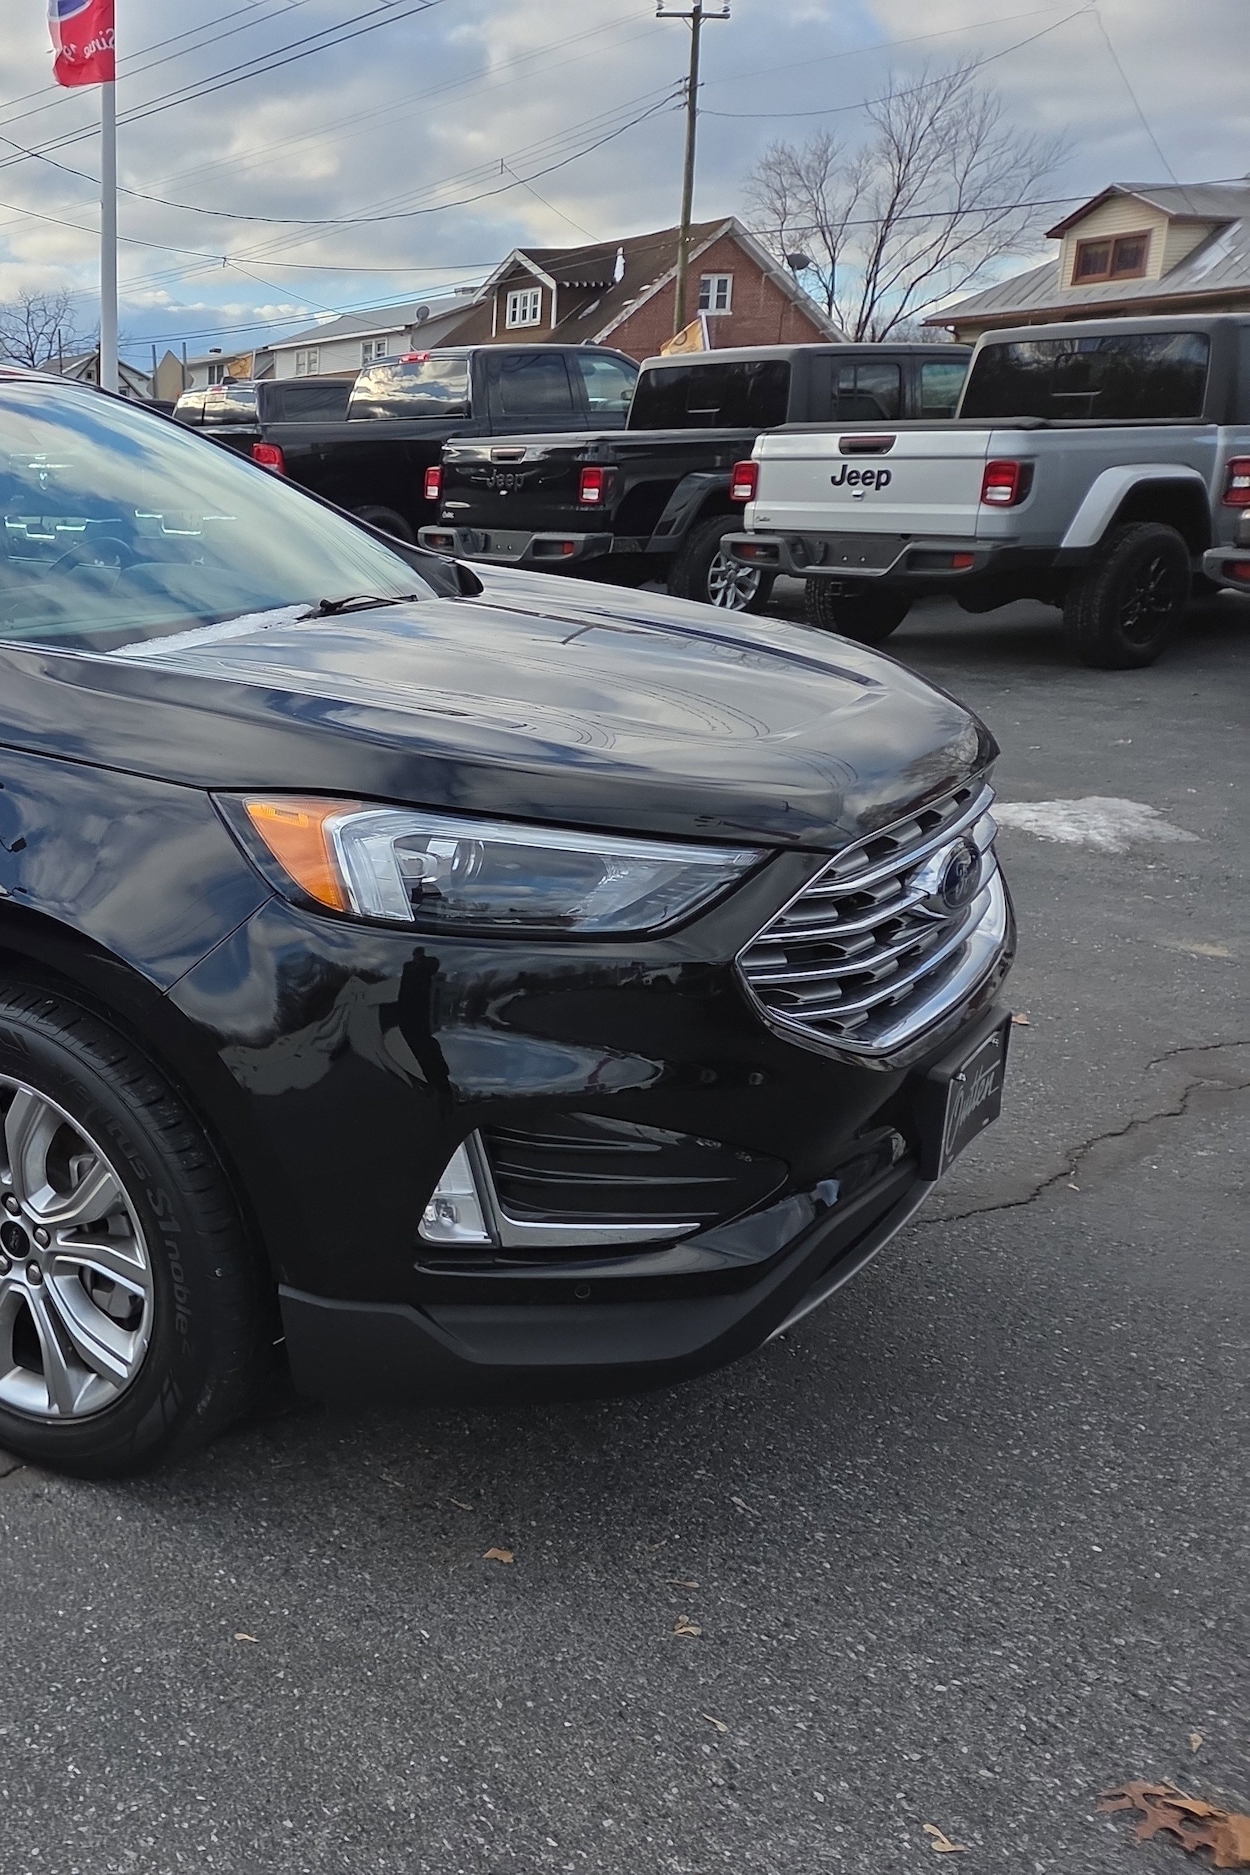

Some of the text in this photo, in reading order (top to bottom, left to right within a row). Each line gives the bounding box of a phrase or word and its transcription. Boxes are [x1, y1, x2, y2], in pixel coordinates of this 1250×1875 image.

[486, 468, 525, 492] Jeep
[831, 464, 892, 490] Jeep
[147, 1188, 182, 1234] S1
